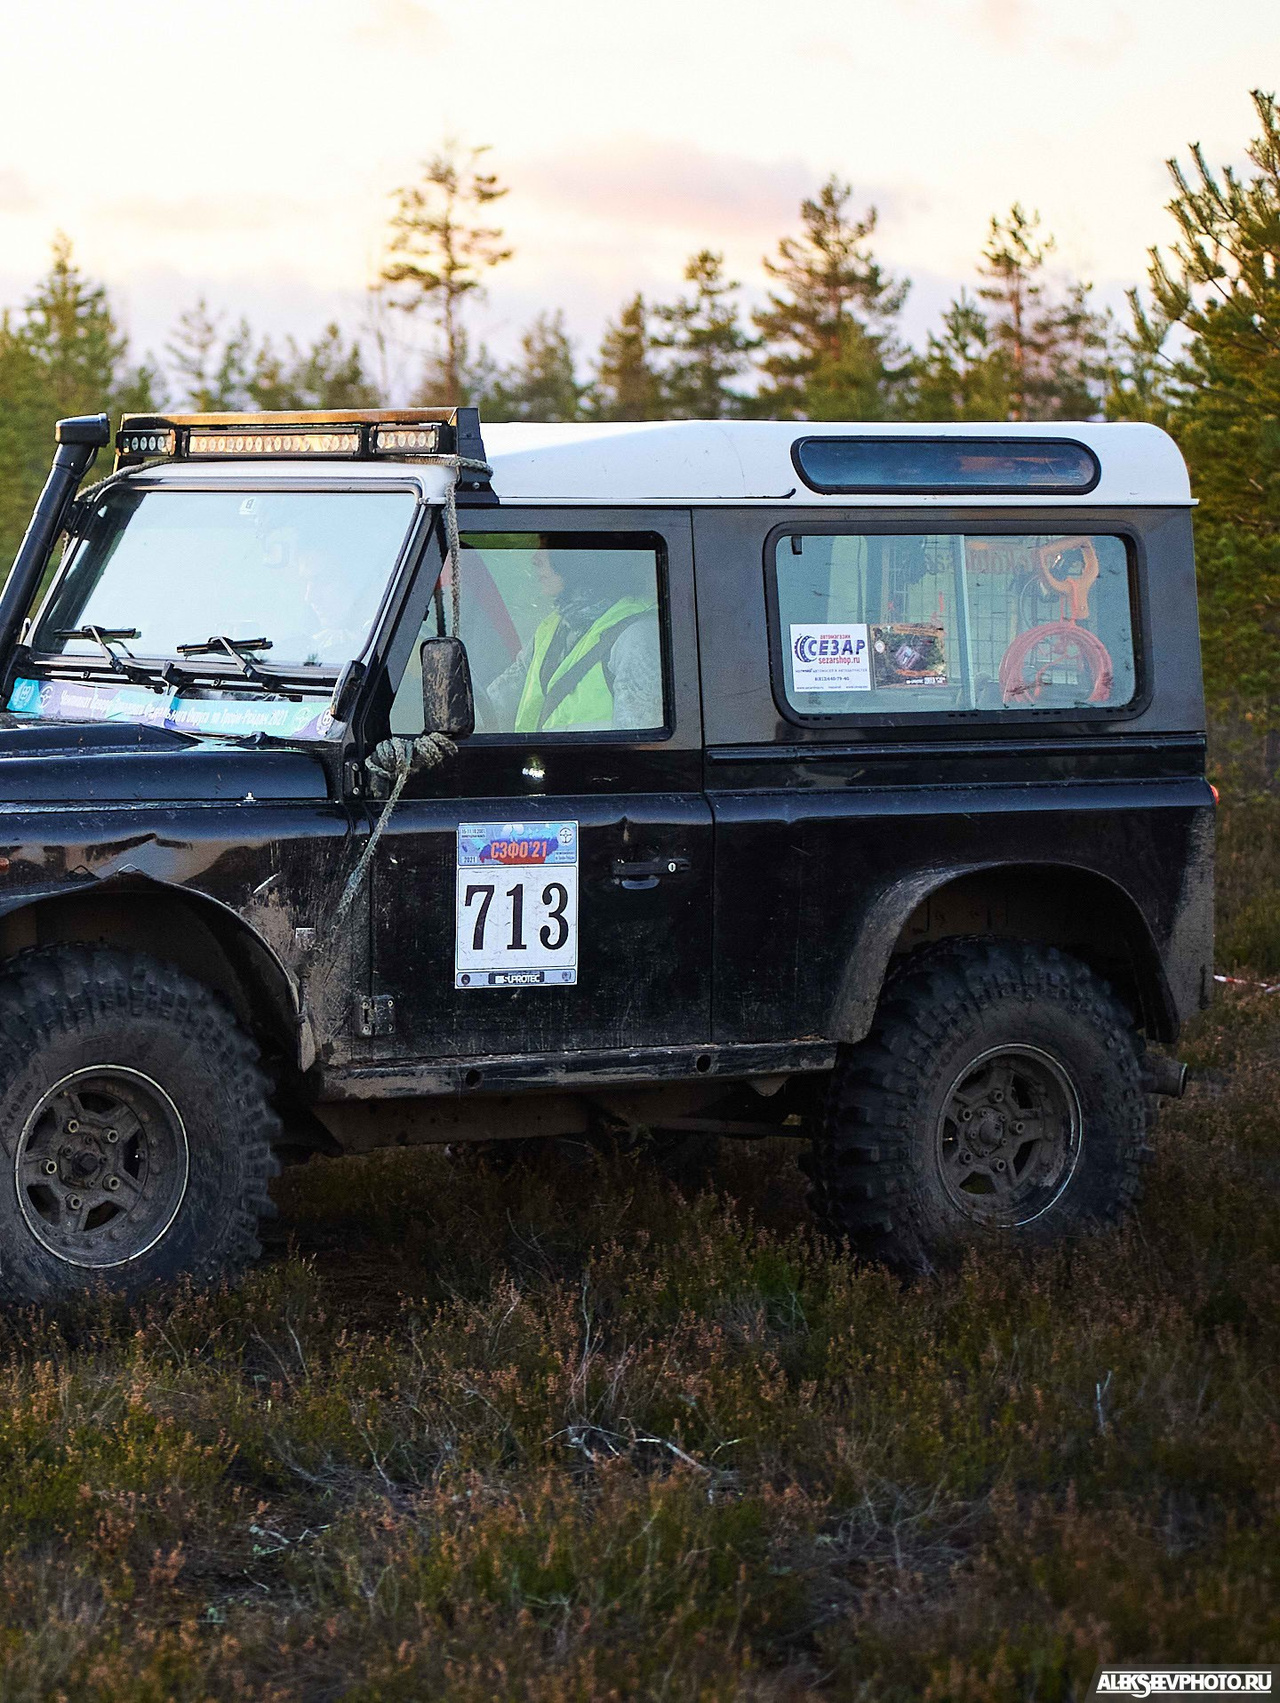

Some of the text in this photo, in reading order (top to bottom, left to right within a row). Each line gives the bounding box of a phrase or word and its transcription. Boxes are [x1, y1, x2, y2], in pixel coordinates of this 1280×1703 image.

[808, 639, 866, 656] СЕЗАР
[818, 655, 861, 665] sezarshop.ru
[464, 882, 569, 951] 713
